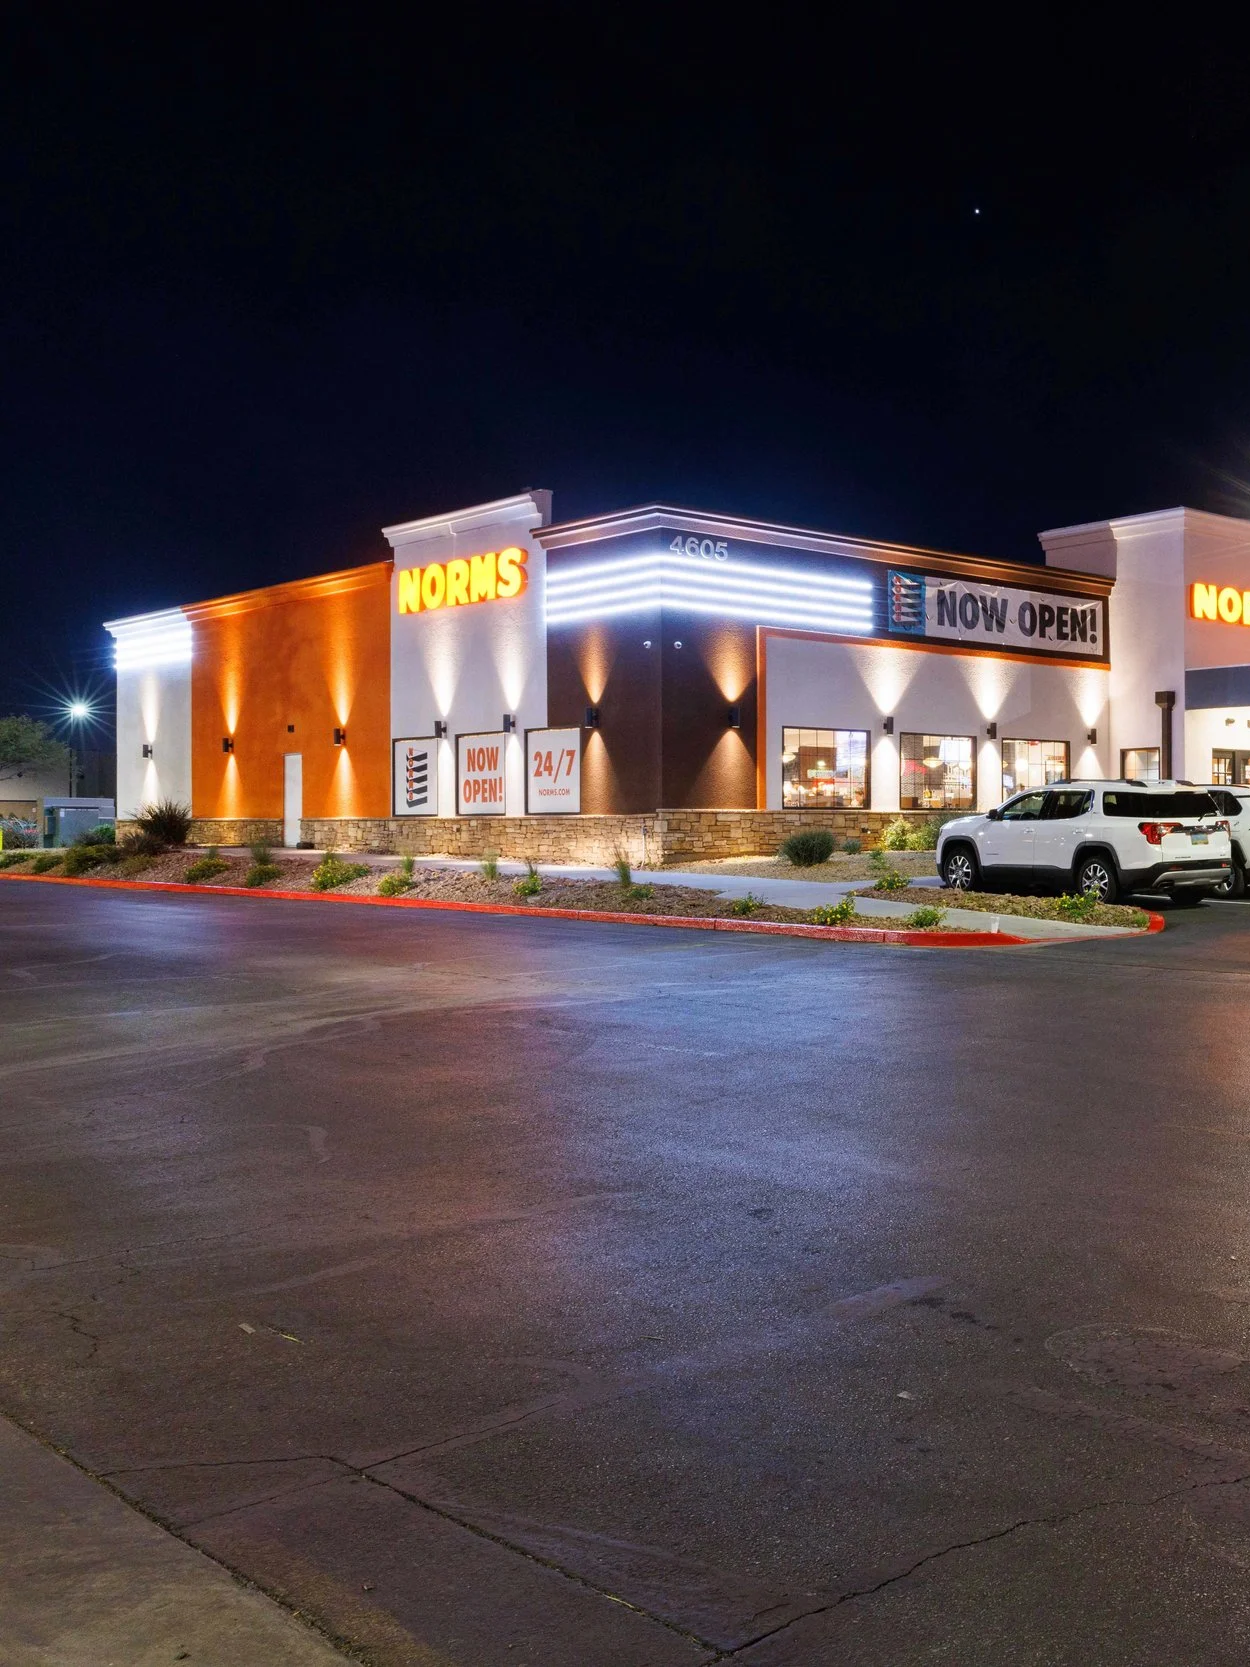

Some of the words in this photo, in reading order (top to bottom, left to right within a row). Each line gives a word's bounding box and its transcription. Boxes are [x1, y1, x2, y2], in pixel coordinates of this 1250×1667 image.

[670, 535, 729, 561] 4605
[398, 547, 524, 614] NORMS
[937, 589, 1009, 633] NOW
[1018, 601, 1098, 644] OPEN!
[467, 747, 499, 773] NOW
[533, 748, 576, 784] 24/7
[463, 777, 503, 803] OPEN!
[539, 788, 570, 796] NORMS.COM
